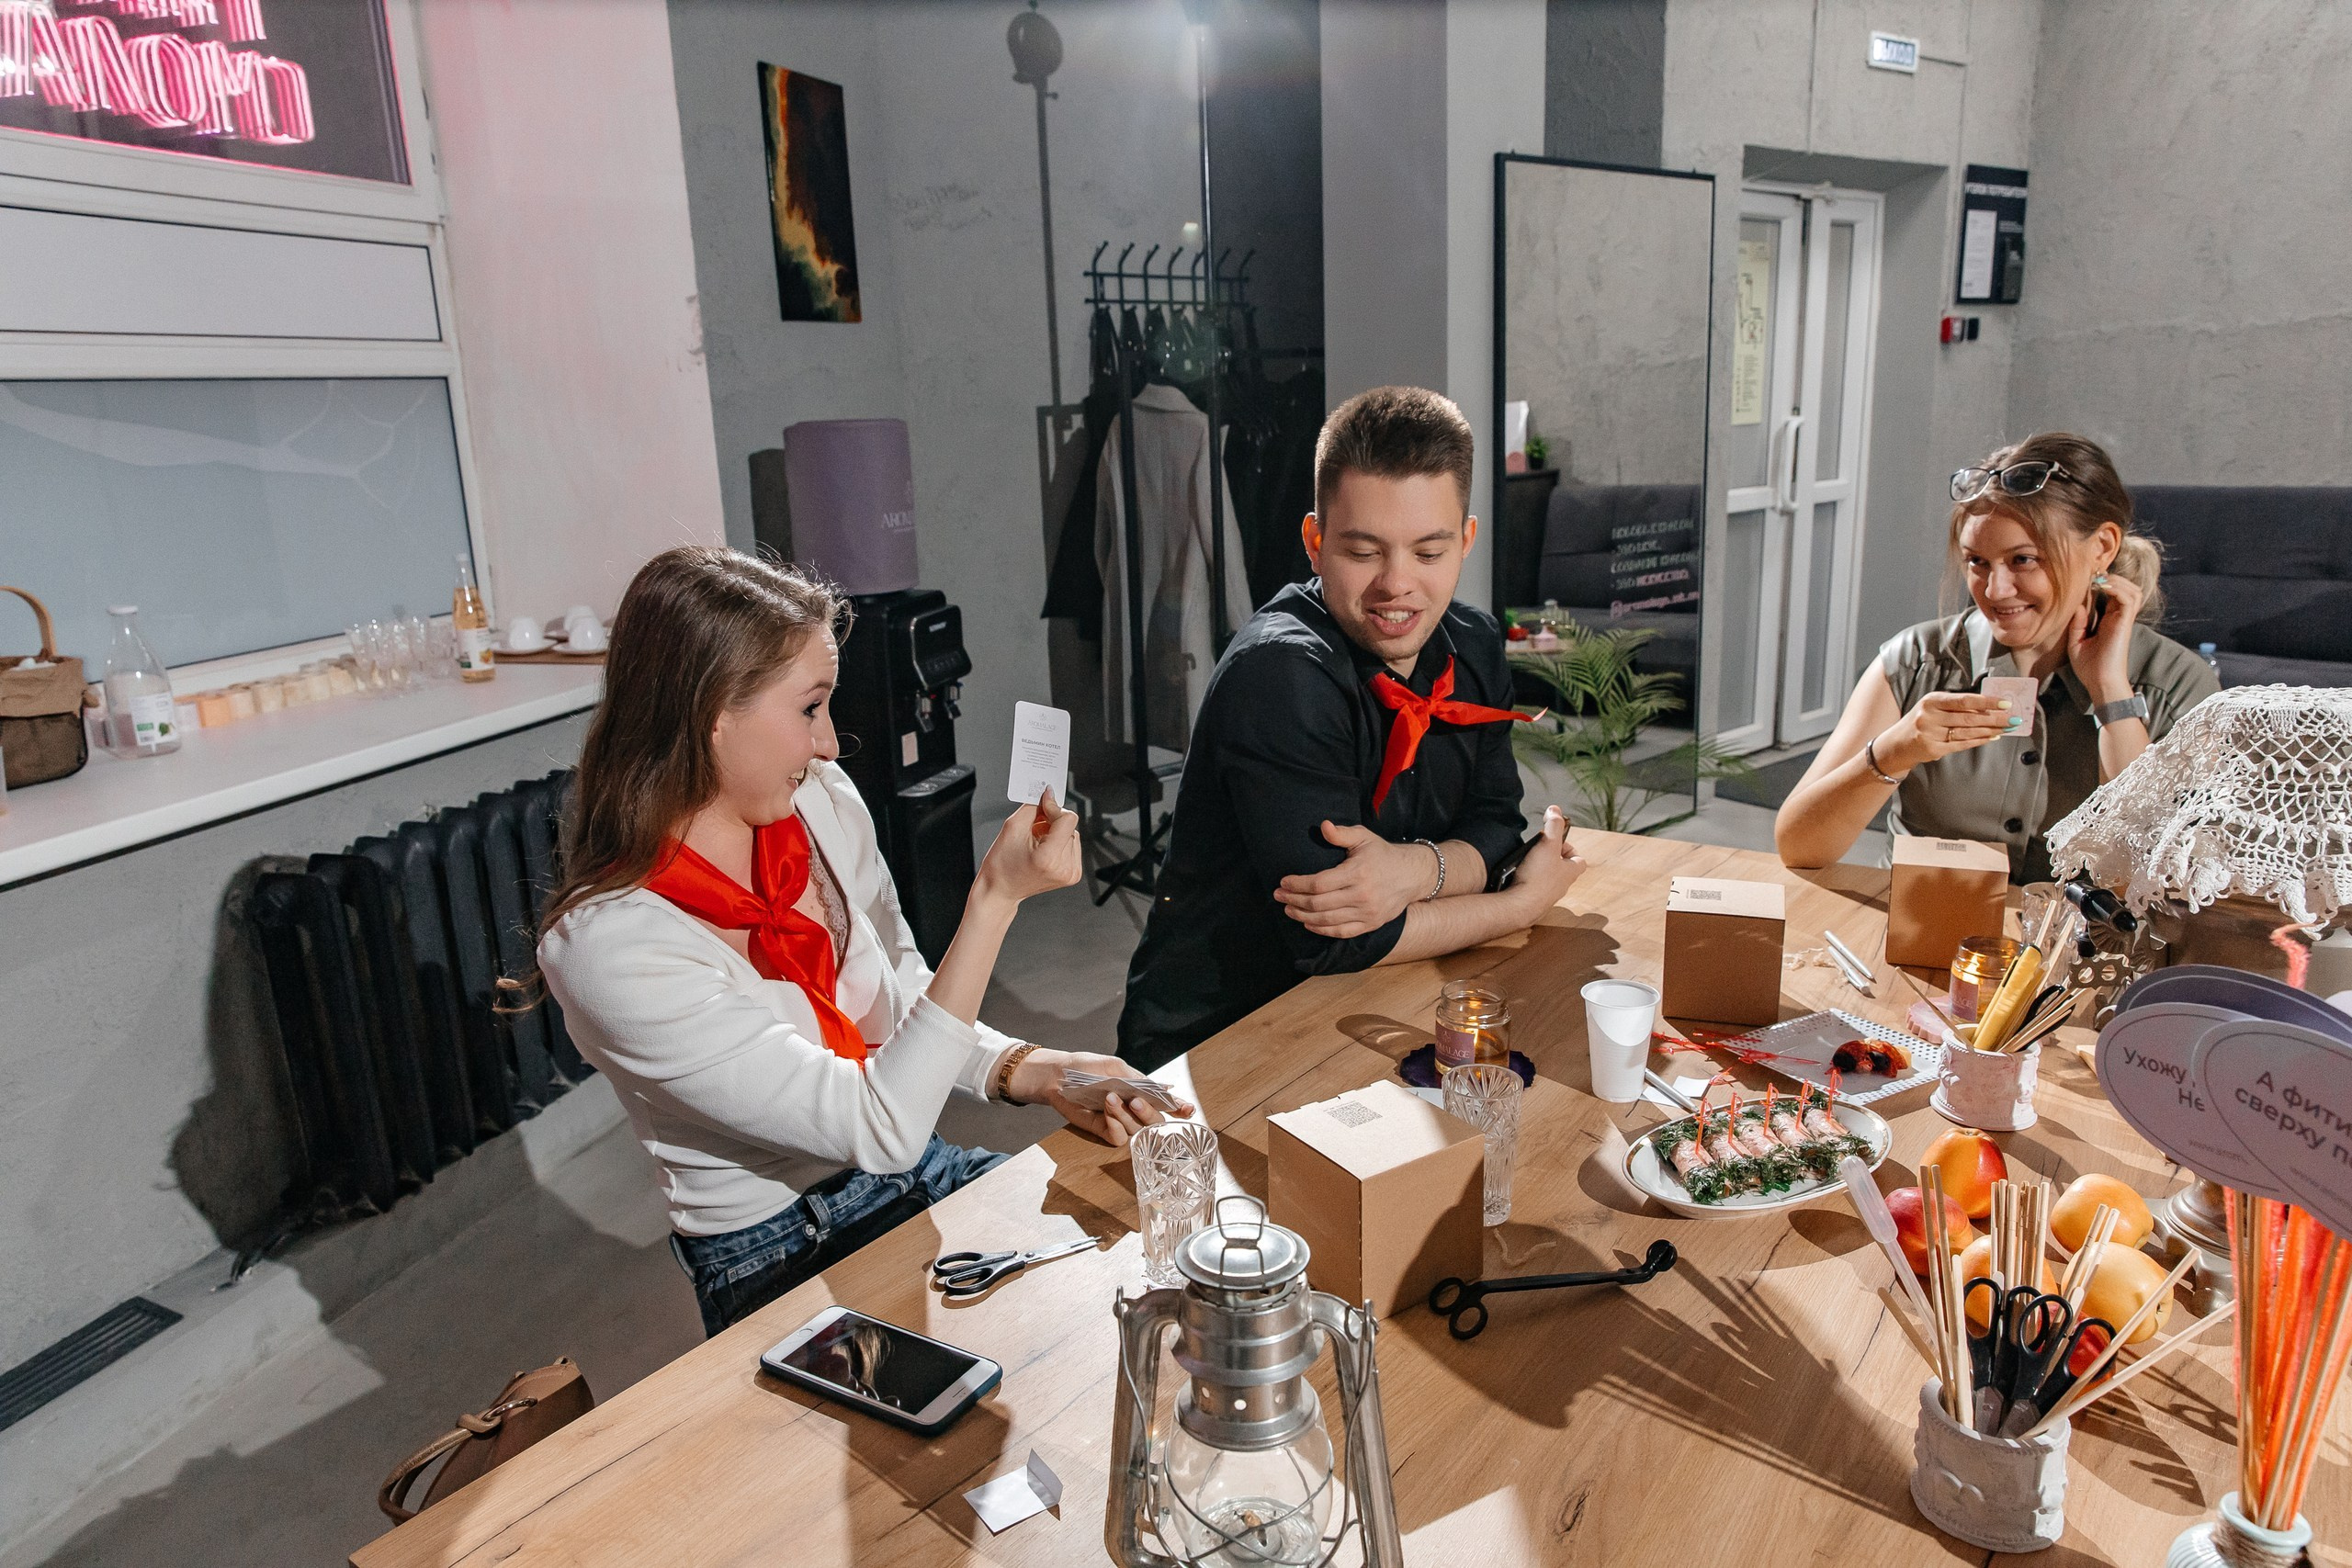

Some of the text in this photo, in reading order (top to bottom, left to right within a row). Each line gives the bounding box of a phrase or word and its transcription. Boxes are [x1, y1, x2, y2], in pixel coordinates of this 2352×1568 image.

[2123, 1046, 2188, 1085] Ухожу
[2256, 1070, 2275, 1093] А
[2234, 1088, 2352, 1169] сверху п
